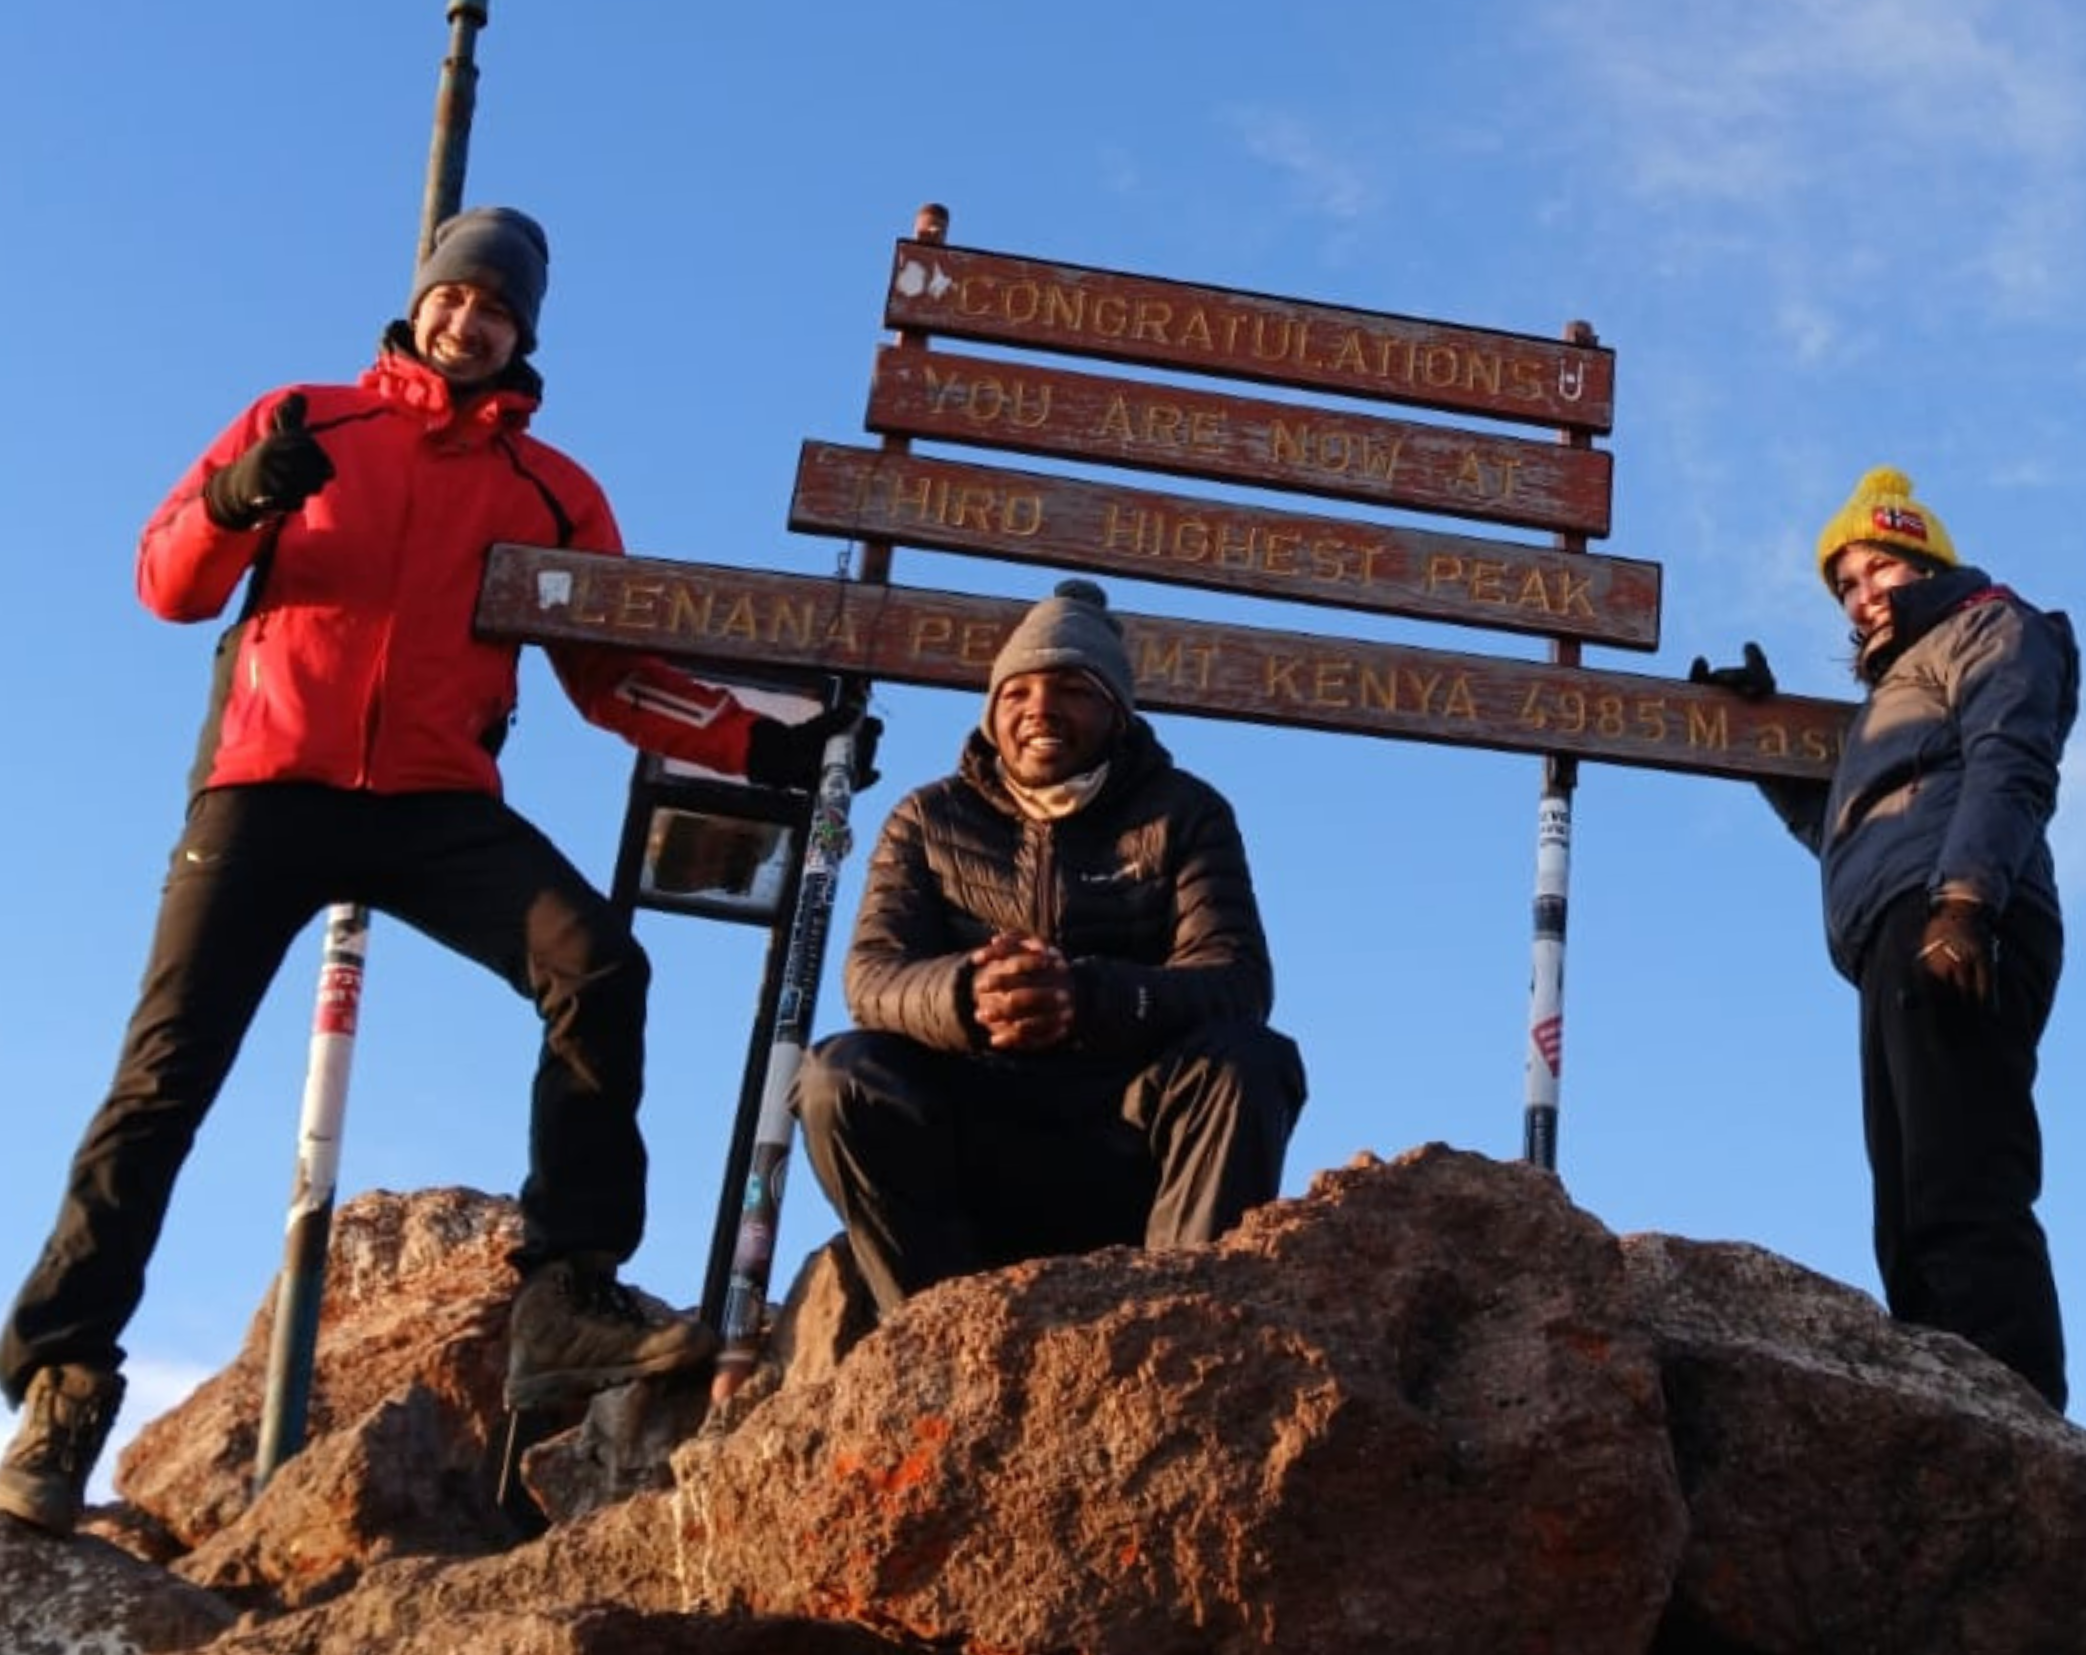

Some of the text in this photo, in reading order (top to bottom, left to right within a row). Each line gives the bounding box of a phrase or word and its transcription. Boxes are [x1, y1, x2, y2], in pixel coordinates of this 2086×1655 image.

[957, 274, 1545, 402] CONGRATULATIONS
[922, 364, 1524, 500] YOU ARE NOW AT
[850, 465, 1596, 618] THIRD HIGHEST PEAK
[571, 574, 858, 654] LENANA
[906, 615, 1000, 667] PE
[1134, 635, 1218, 690] MT
[1262, 654, 1478, 723] KENYA
[1516, 682, 1667, 744] 4985
[1687, 702, 1728, 752] M
